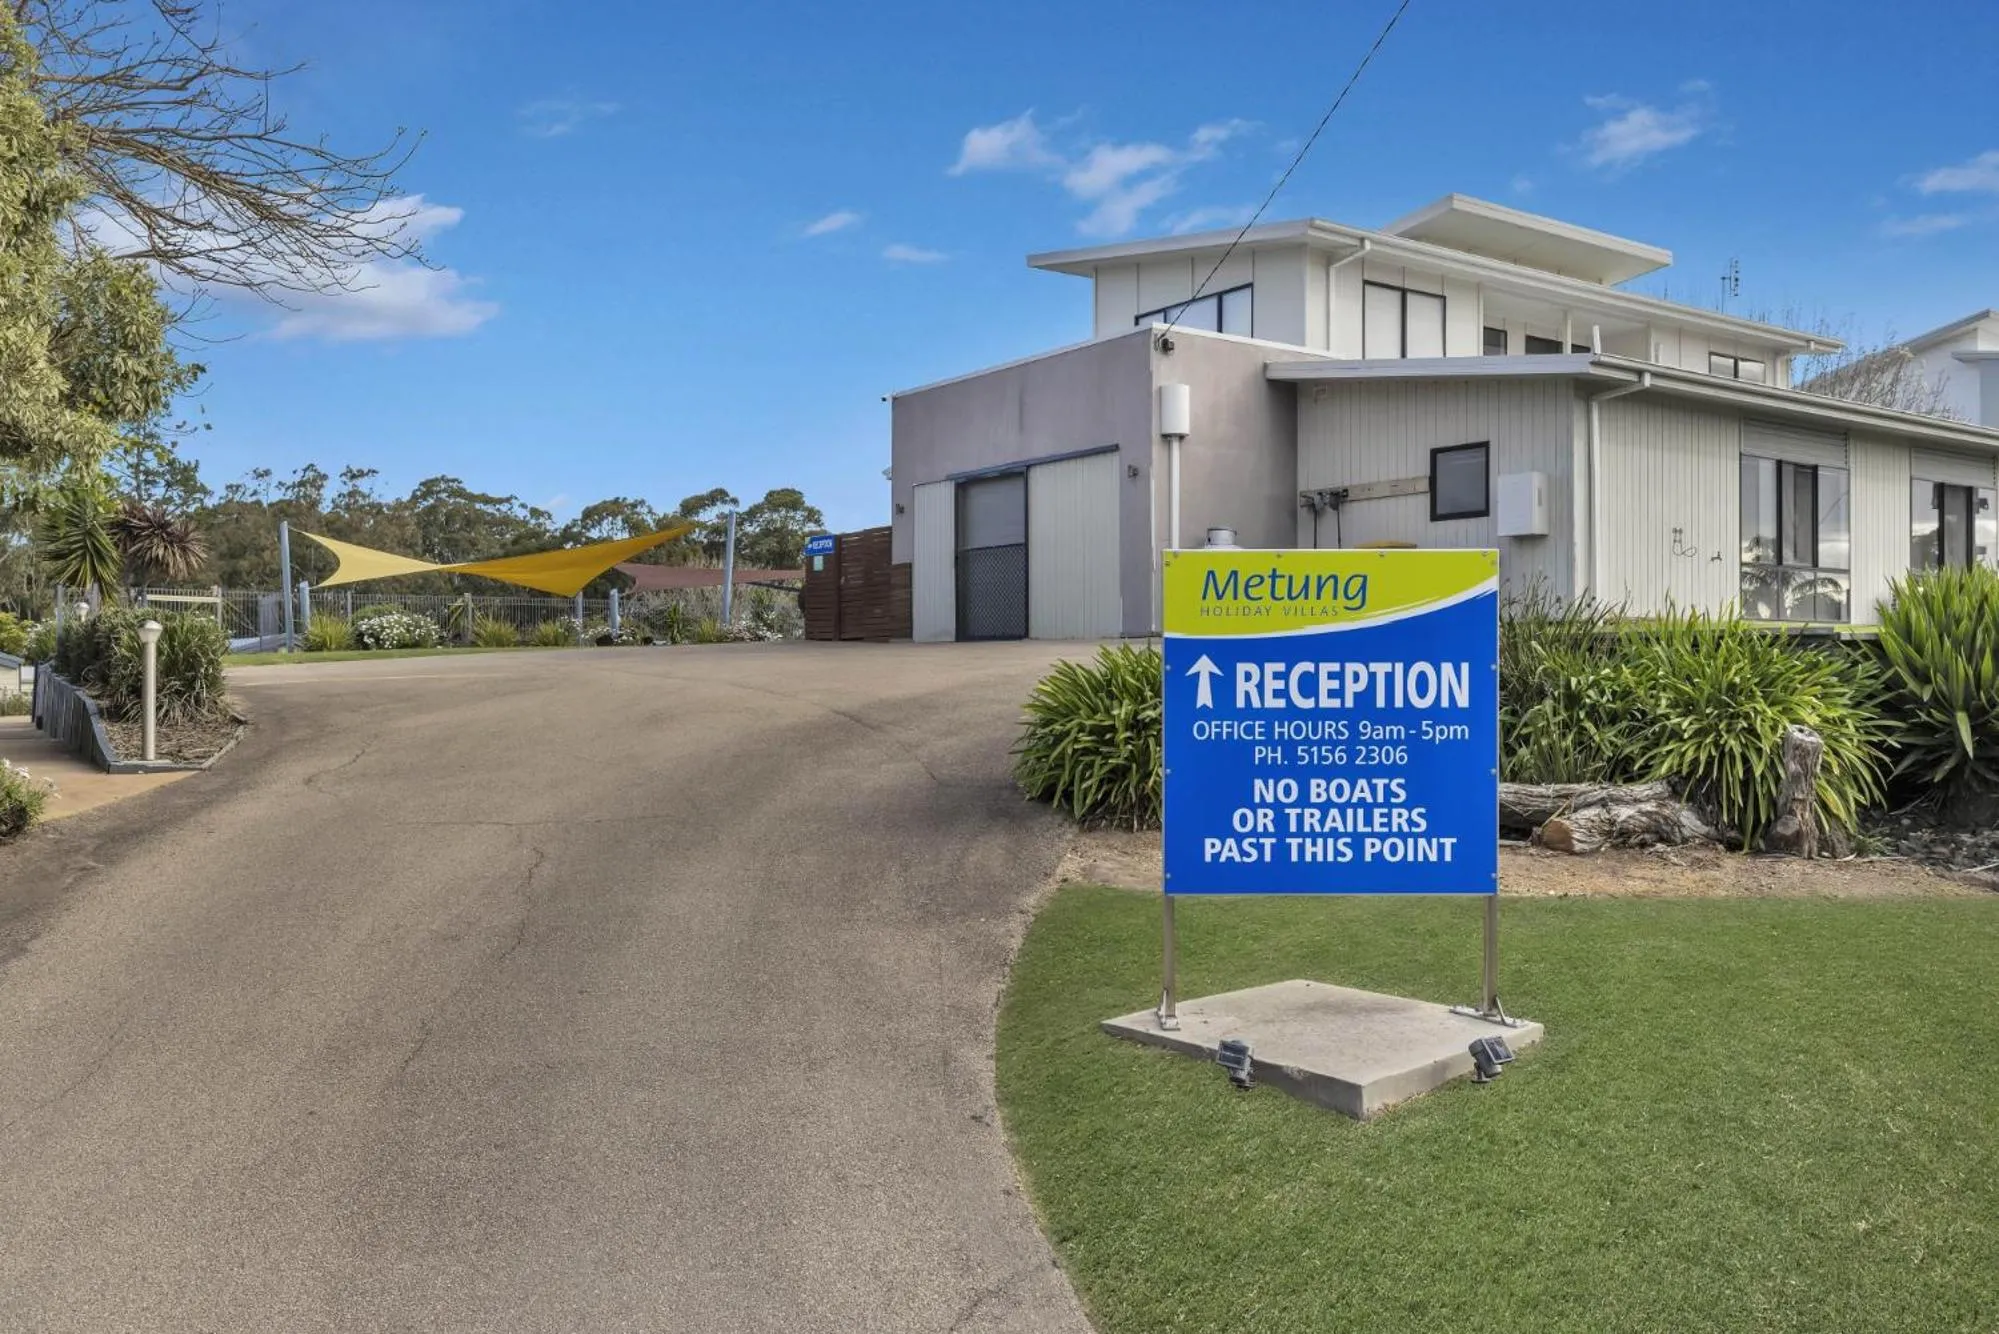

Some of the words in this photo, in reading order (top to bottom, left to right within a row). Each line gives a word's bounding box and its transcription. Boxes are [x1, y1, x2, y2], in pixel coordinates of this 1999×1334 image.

[1201, 567, 1369, 611] Metung
[1200, 606, 1272, 617] HOLIDAY
[1283, 606, 1339, 617] VILLAS
[1236, 661, 1470, 709] RECEPTION
[1193, 720, 1265, 740] OFFICE
[1274, 720, 1349, 740] HOURS
[1254, 746, 1288, 765] PH.
[1297, 745, 1347, 765] 5156
[1355, 745, 1408, 765] 2306
[1253, 778, 1299, 804] NO
[1310, 778, 1407, 804] BOATS
[1232, 807, 1275, 833] OR
[1284, 807, 1427, 833] TRAILERS
[1204, 837, 1277, 863] PAST
[1285, 837, 1353, 863] THIS
[1364, 837, 1457, 863] POINT
